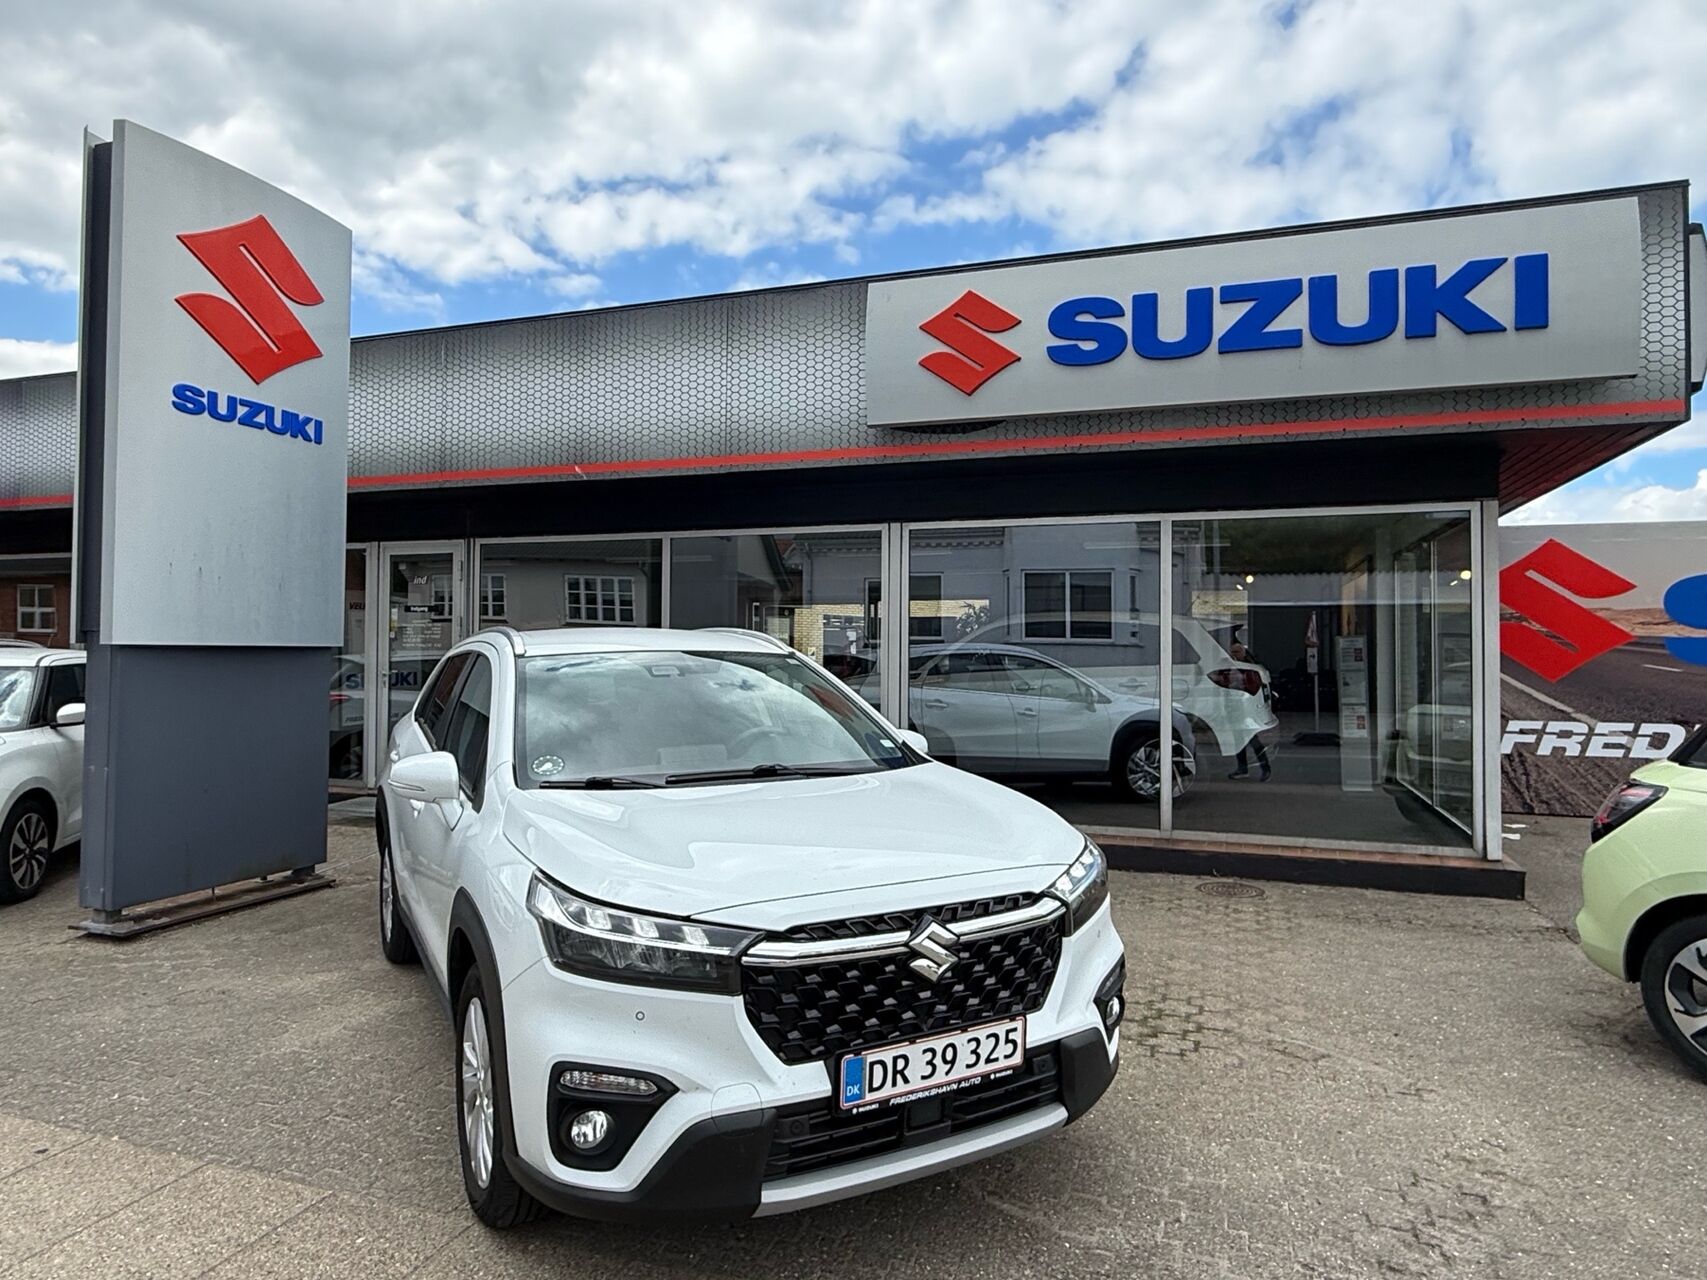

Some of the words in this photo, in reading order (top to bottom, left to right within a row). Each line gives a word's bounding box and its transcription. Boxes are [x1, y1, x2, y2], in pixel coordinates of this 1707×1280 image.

[1046, 253, 1549, 366] SUZUKI
[172, 383, 323, 445] SUZUKI
[346, 672, 417, 689] SUKI
[1501, 720, 1701, 759] FRED
[868, 1053, 911, 1093] DR
[920, 1042, 958, 1080] 39
[965, 1026, 1018, 1069] 325
[846, 1084, 860, 1096] DK
[889, 1082, 958, 1105] FREDERIKSHAVN
[959, 1076, 982, 1089] AUTO
